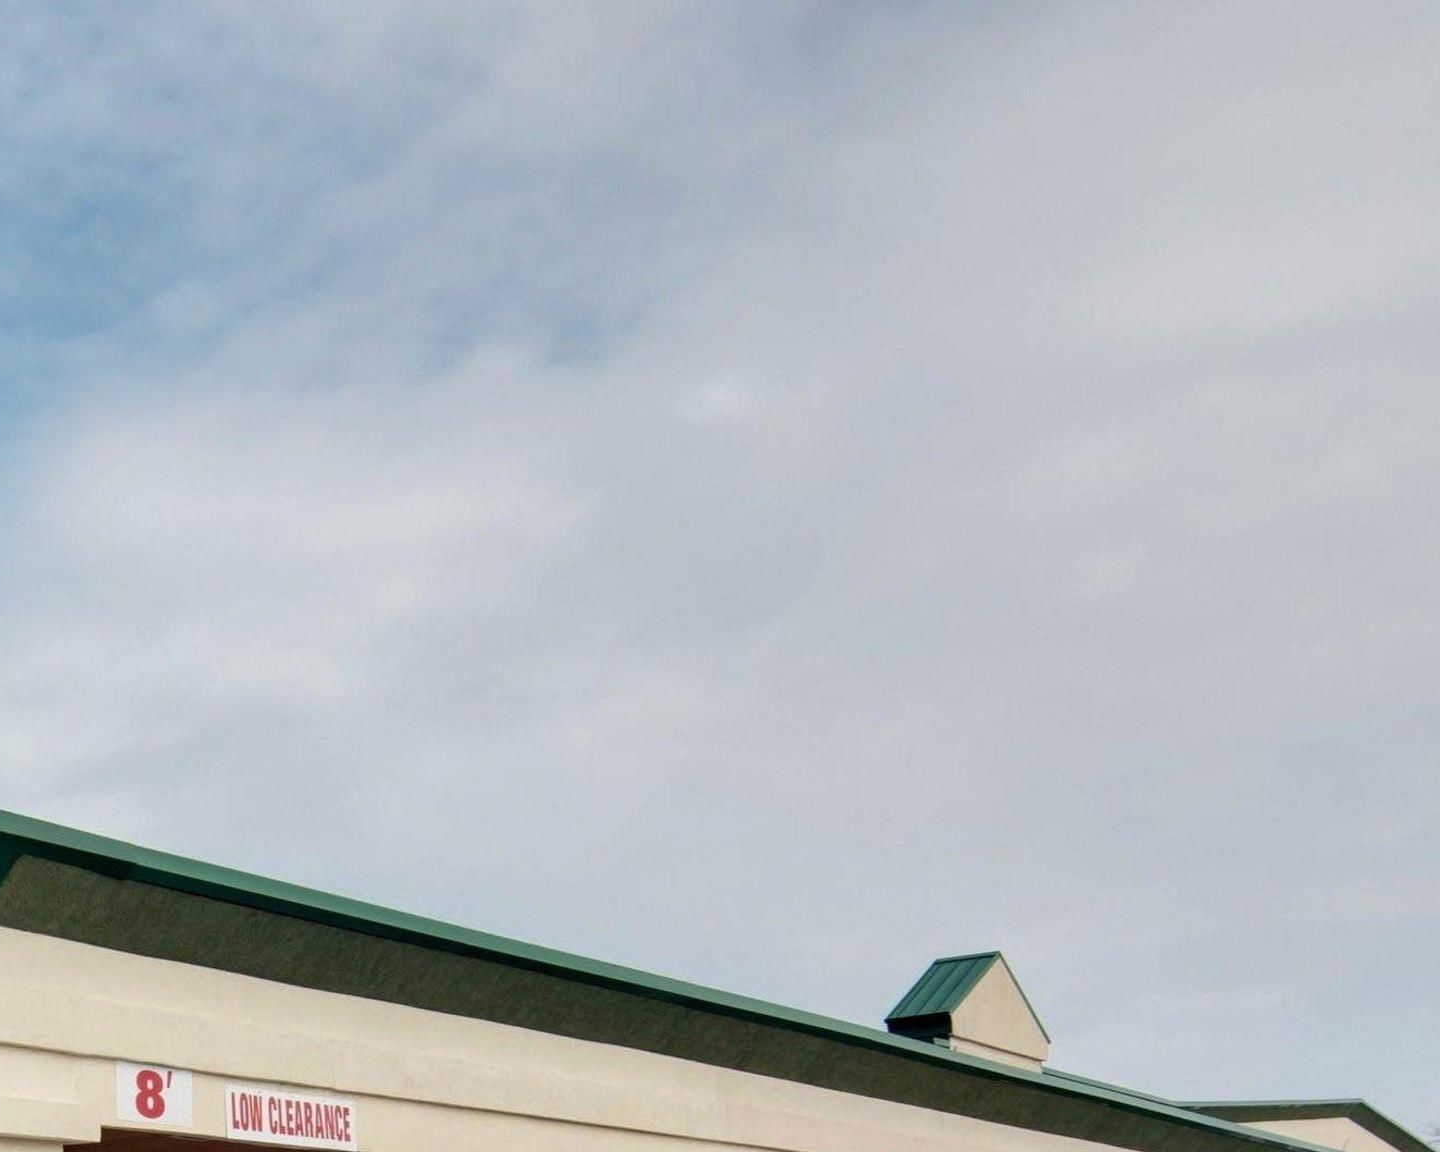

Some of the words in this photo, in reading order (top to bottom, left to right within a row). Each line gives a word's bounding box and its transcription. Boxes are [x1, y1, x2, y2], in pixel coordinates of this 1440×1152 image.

[135, 1068, 173, 1120] 8'
[231, 1091, 263, 1133] LOW
[268, 1096, 352, 1143] CLEARANCE
